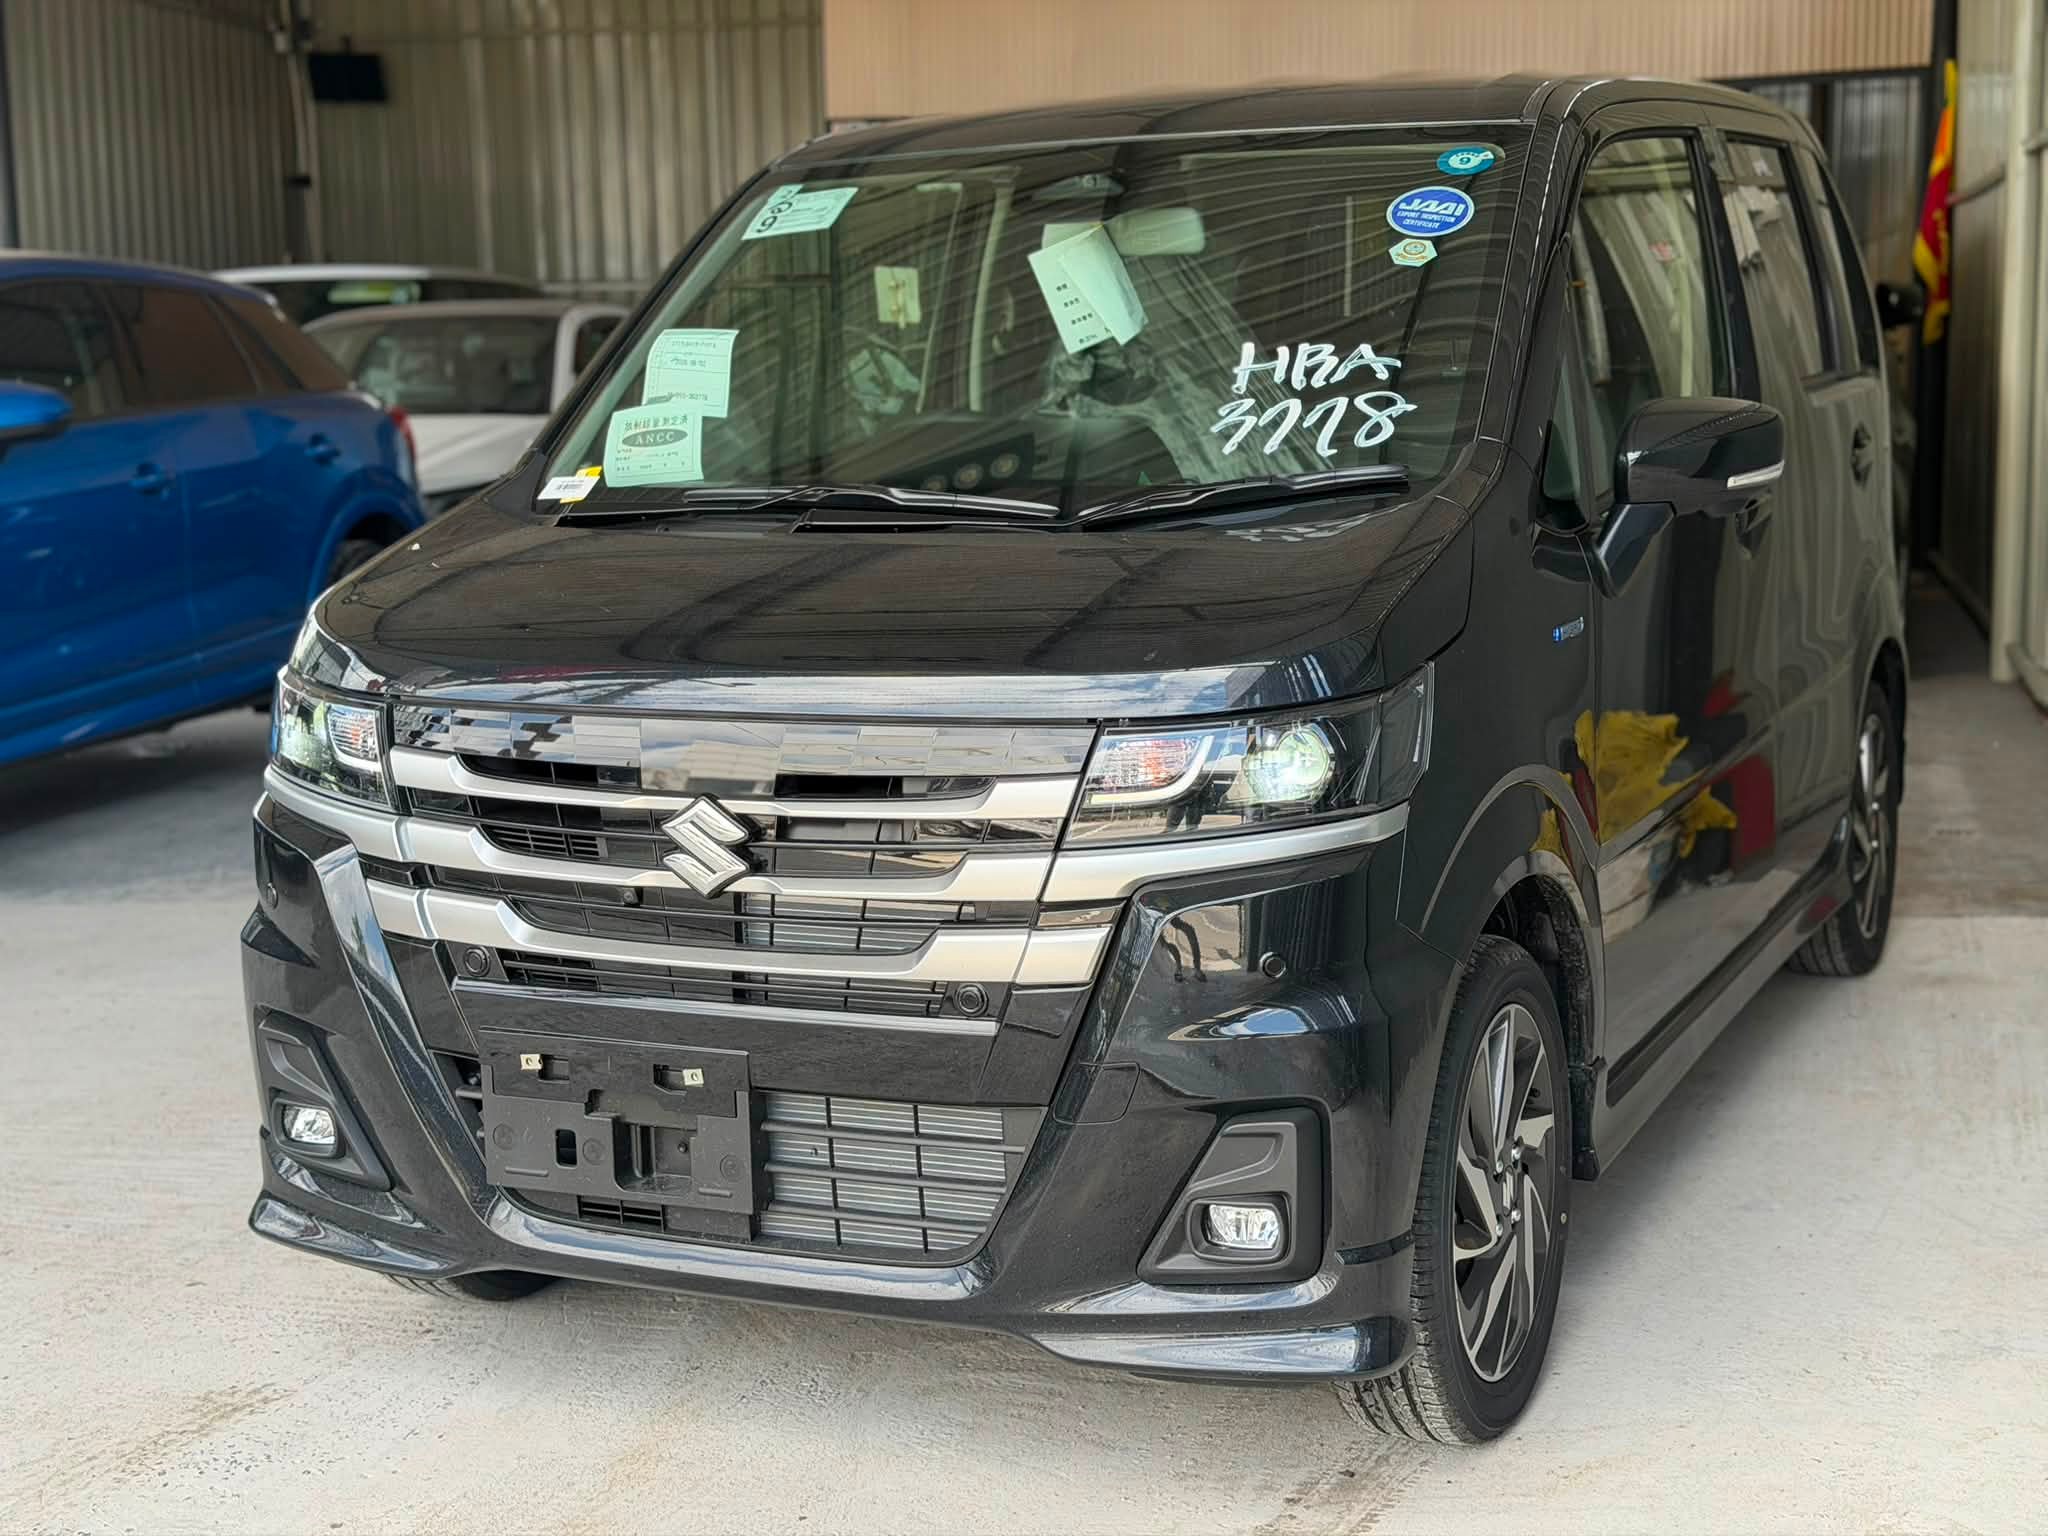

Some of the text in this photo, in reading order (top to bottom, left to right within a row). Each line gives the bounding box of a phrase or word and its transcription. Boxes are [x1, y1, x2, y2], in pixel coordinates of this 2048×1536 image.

[1399, 198, 1466, 216] JAAI
[1397, 210, 1456, 223] EXPORT INSPECTION
[1402, 218, 1440, 229] CERTIFICATE
[634, 431, 675, 445] ANCC
